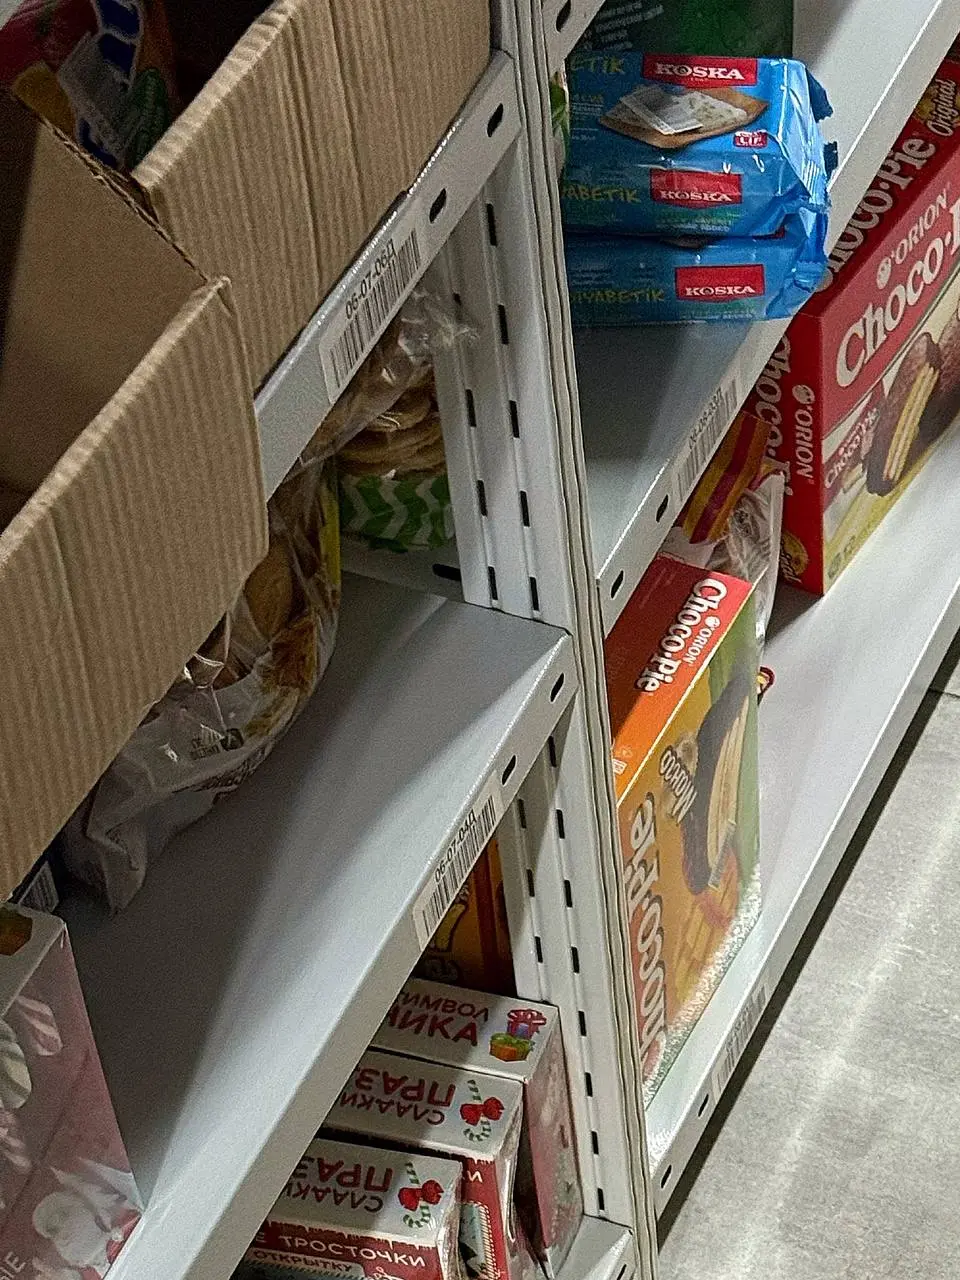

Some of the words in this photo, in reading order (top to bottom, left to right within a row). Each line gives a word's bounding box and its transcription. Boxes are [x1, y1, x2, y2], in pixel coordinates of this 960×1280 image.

[655, 62, 745, 80] KOSKA
[926, 79, 958, 137] Original
[660, 190, 733, 202] KOSKA
[891, 190, 948, 264] ORION
[685, 286, 756, 297] KOSKA
[794, 408, 816, 479] ORION
[683, 626, 715, 666] ORION
[255, 1250, 352, 1273] ОТКРЫТКУ
[279, 1235, 426, 1268] ТРОСТОЧКИ
